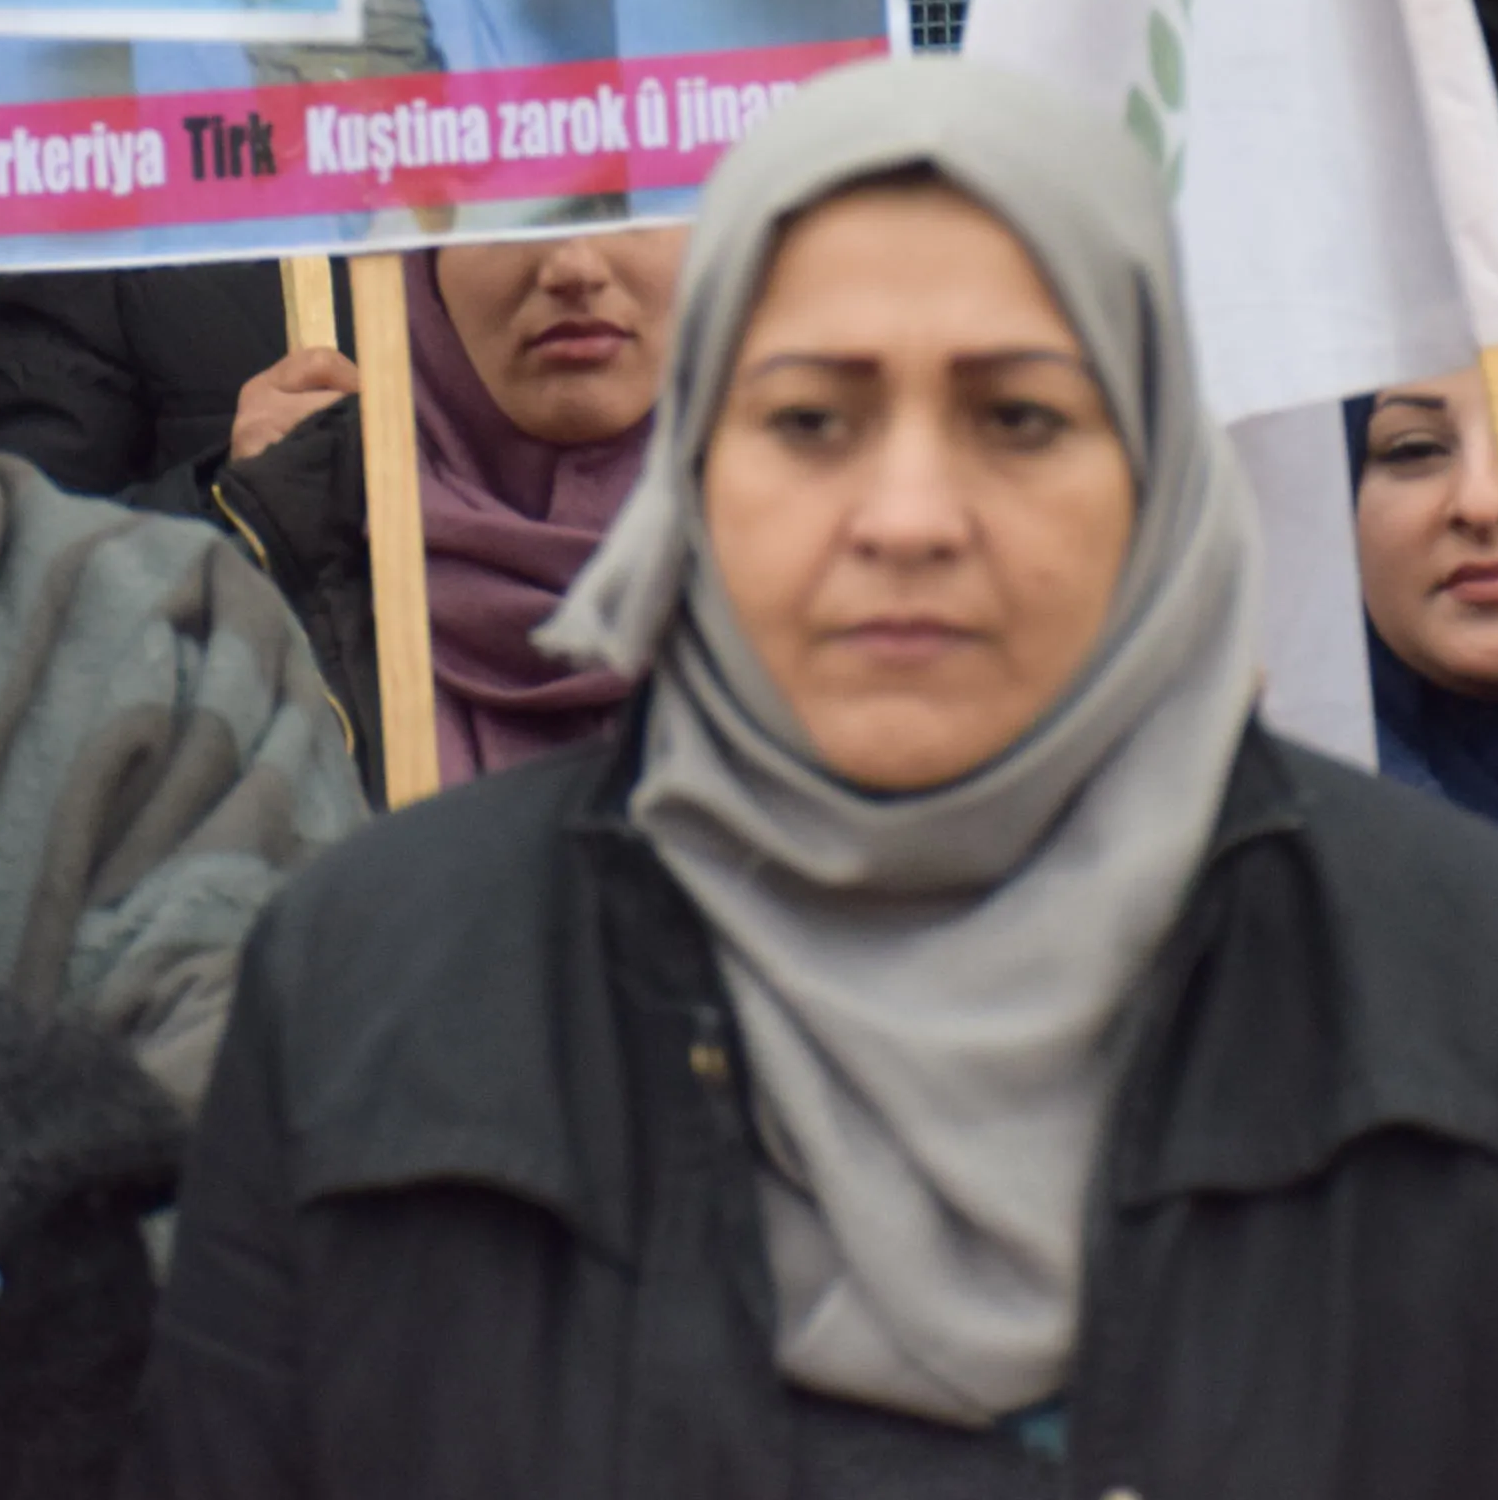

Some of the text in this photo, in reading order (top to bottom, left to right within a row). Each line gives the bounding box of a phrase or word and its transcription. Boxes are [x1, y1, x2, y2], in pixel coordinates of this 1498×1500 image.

[183, 111, 277, 182] Tirk
[304, 97, 490, 185] Kuştina
[498, 83, 630, 161] zarok
[636, 77, 671, 150] û
